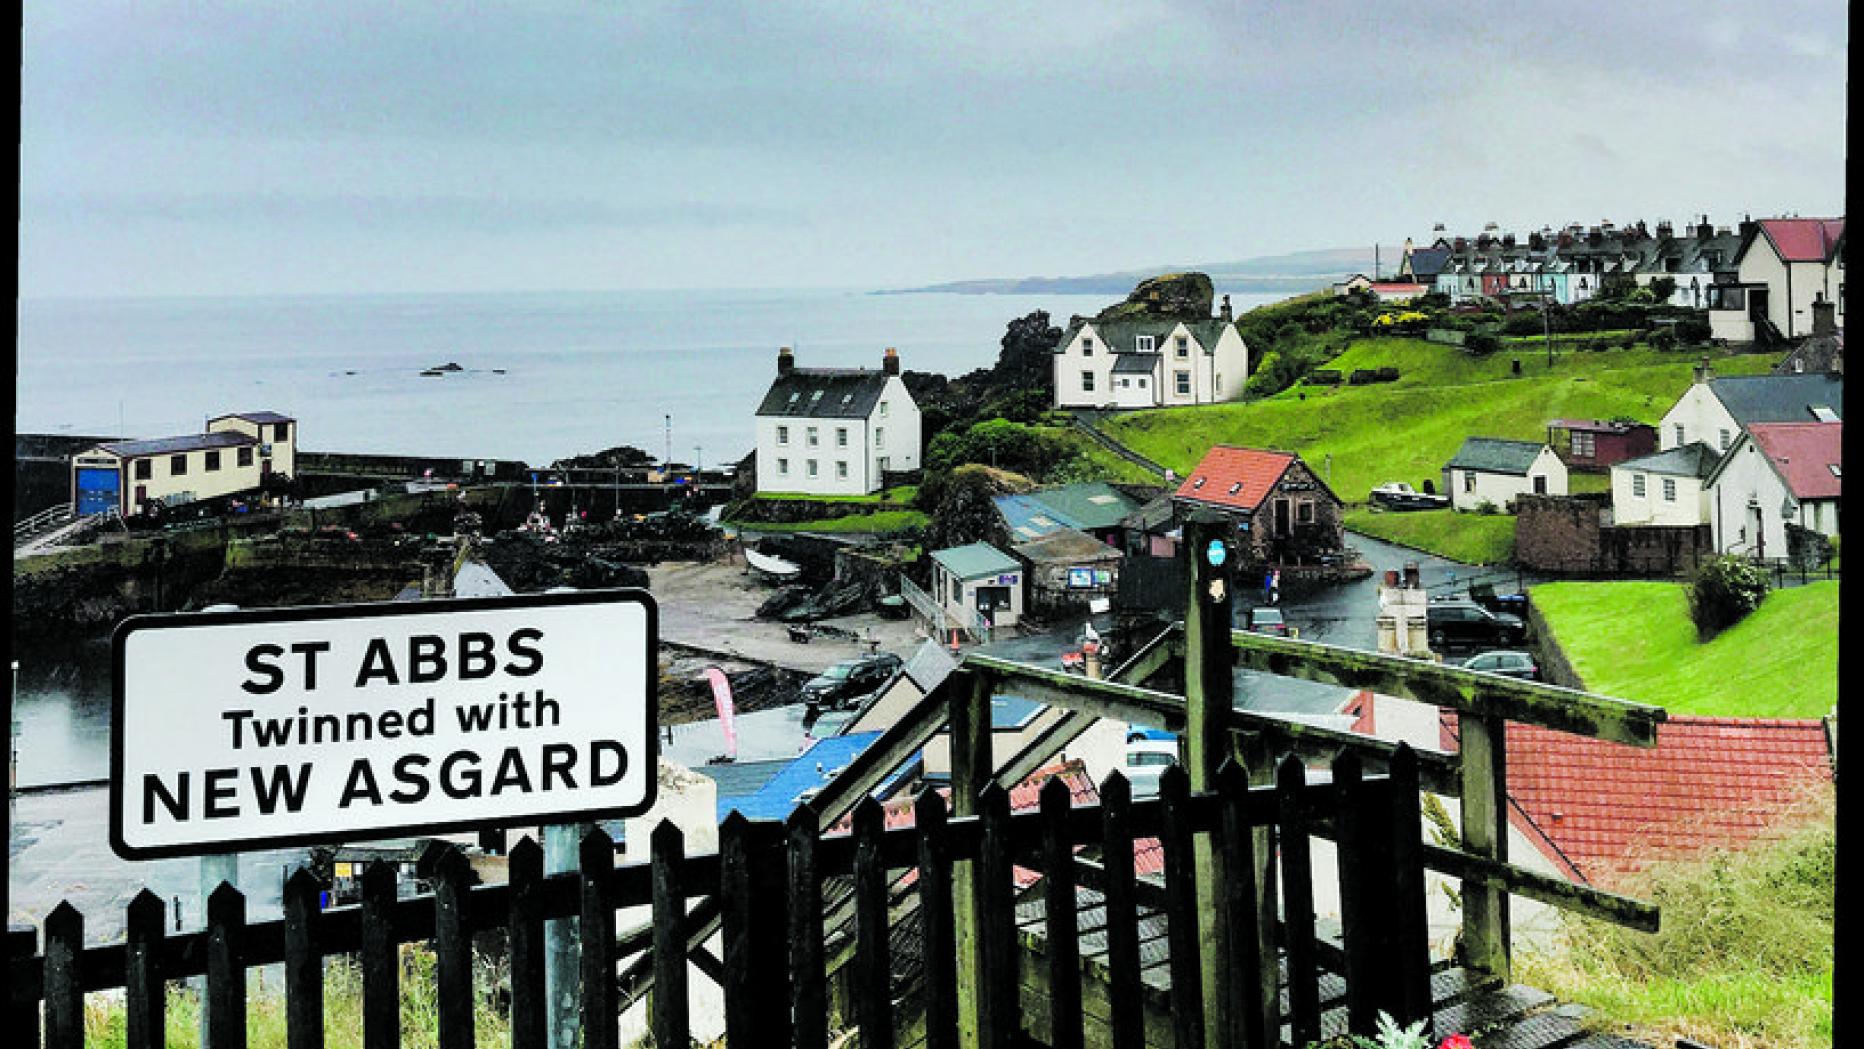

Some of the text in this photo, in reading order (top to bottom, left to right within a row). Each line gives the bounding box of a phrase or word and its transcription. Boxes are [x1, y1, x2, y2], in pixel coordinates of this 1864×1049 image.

[241, 627, 544, 695] ST ABBS
[222, 689, 560, 749] Twinned with
[143, 739, 629, 825] NEW ASGARD
